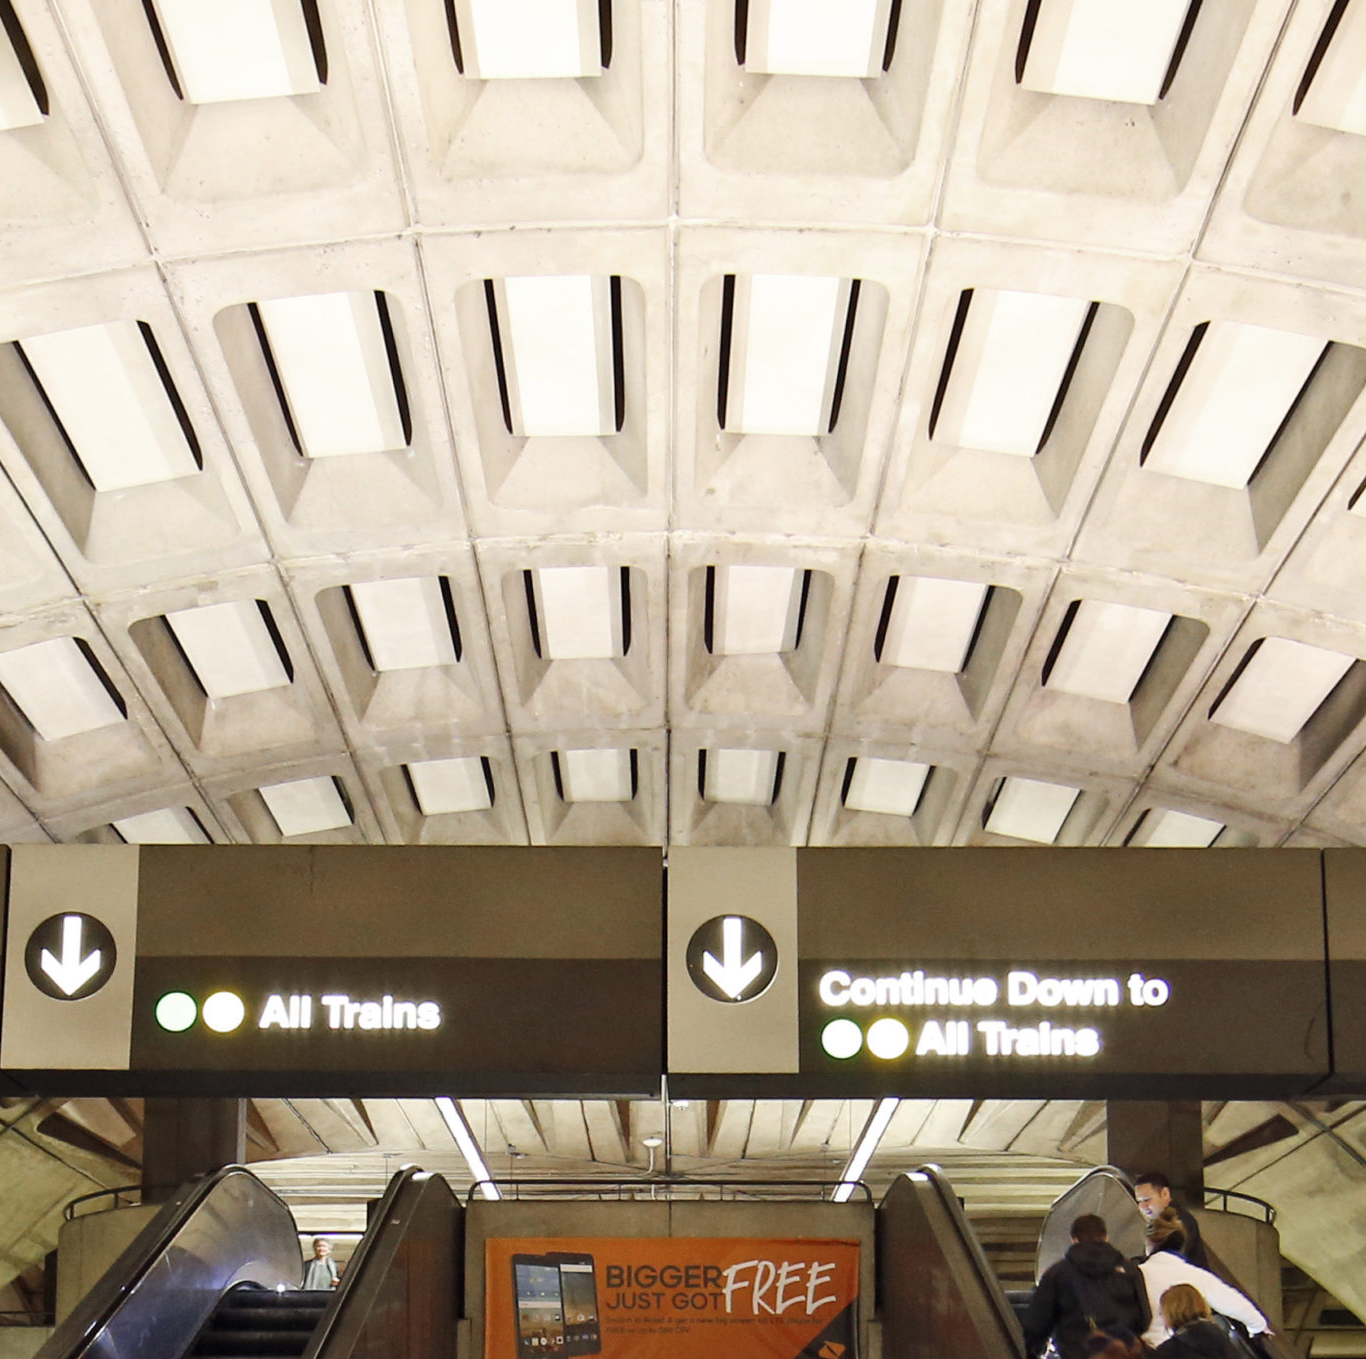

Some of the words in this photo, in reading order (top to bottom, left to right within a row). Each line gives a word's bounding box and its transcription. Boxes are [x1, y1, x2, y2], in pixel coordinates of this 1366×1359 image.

[819, 971, 999, 1007] Continue
[1007, 971, 1120, 1007] Down
[1127, 973, 1169, 1006] to
[258, 994, 313, 1029] All
[320, 994, 442, 1030] Trains
[915, 1019, 970, 1056] All
[976, 1019, 1101, 1057] Trains
[606, 1265, 723, 1288] BIGGER
[722, 1259, 836, 1315] FREE
[606, 1292, 665, 1310] JUST
[673, 1292, 723, 1310] GOT
